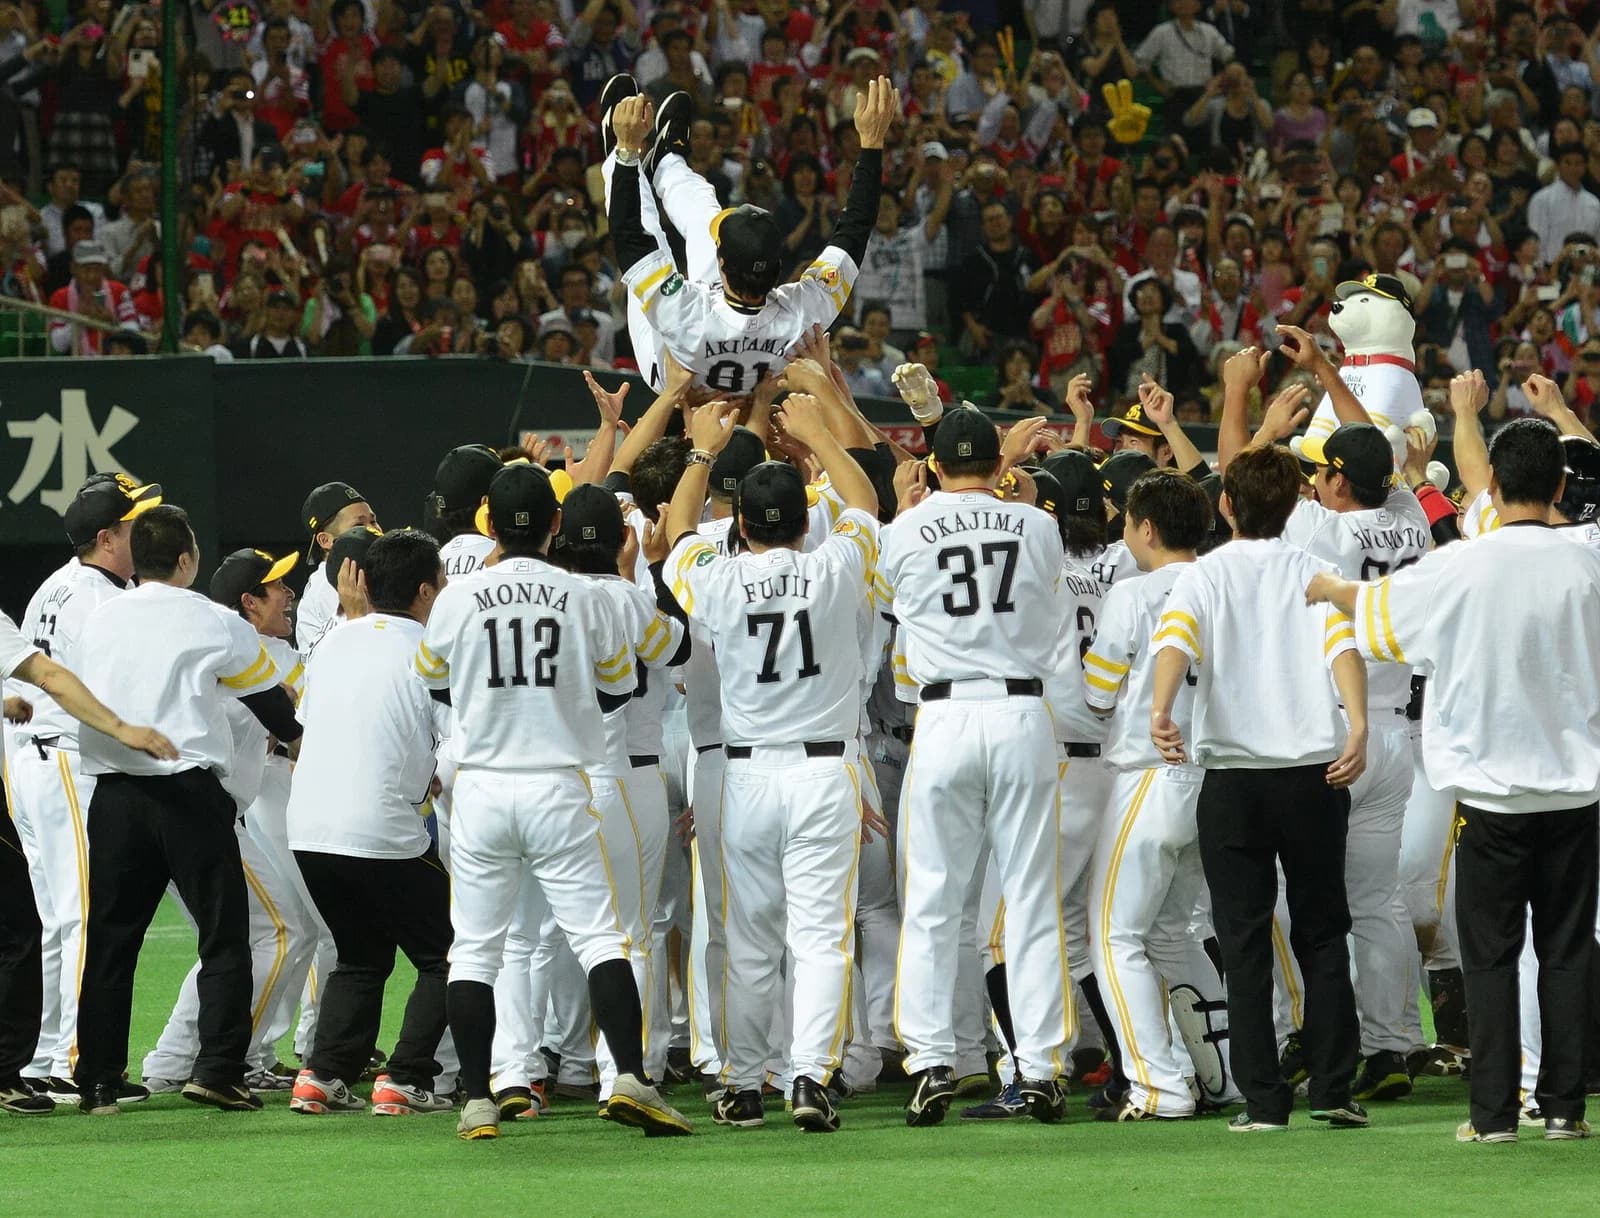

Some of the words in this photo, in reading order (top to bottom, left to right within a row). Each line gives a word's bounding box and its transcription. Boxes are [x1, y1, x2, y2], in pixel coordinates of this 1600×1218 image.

[0, 389, 143, 517] 水
[920, 511, 1025, 544] OKAJIMA
[473, 582, 569, 613] MONNA
[743, 574, 812, 603] FUJII
[937, 541, 1019, 617] 37
[483, 617, 560, 688] 112
[747, 609, 822, 684] 71
